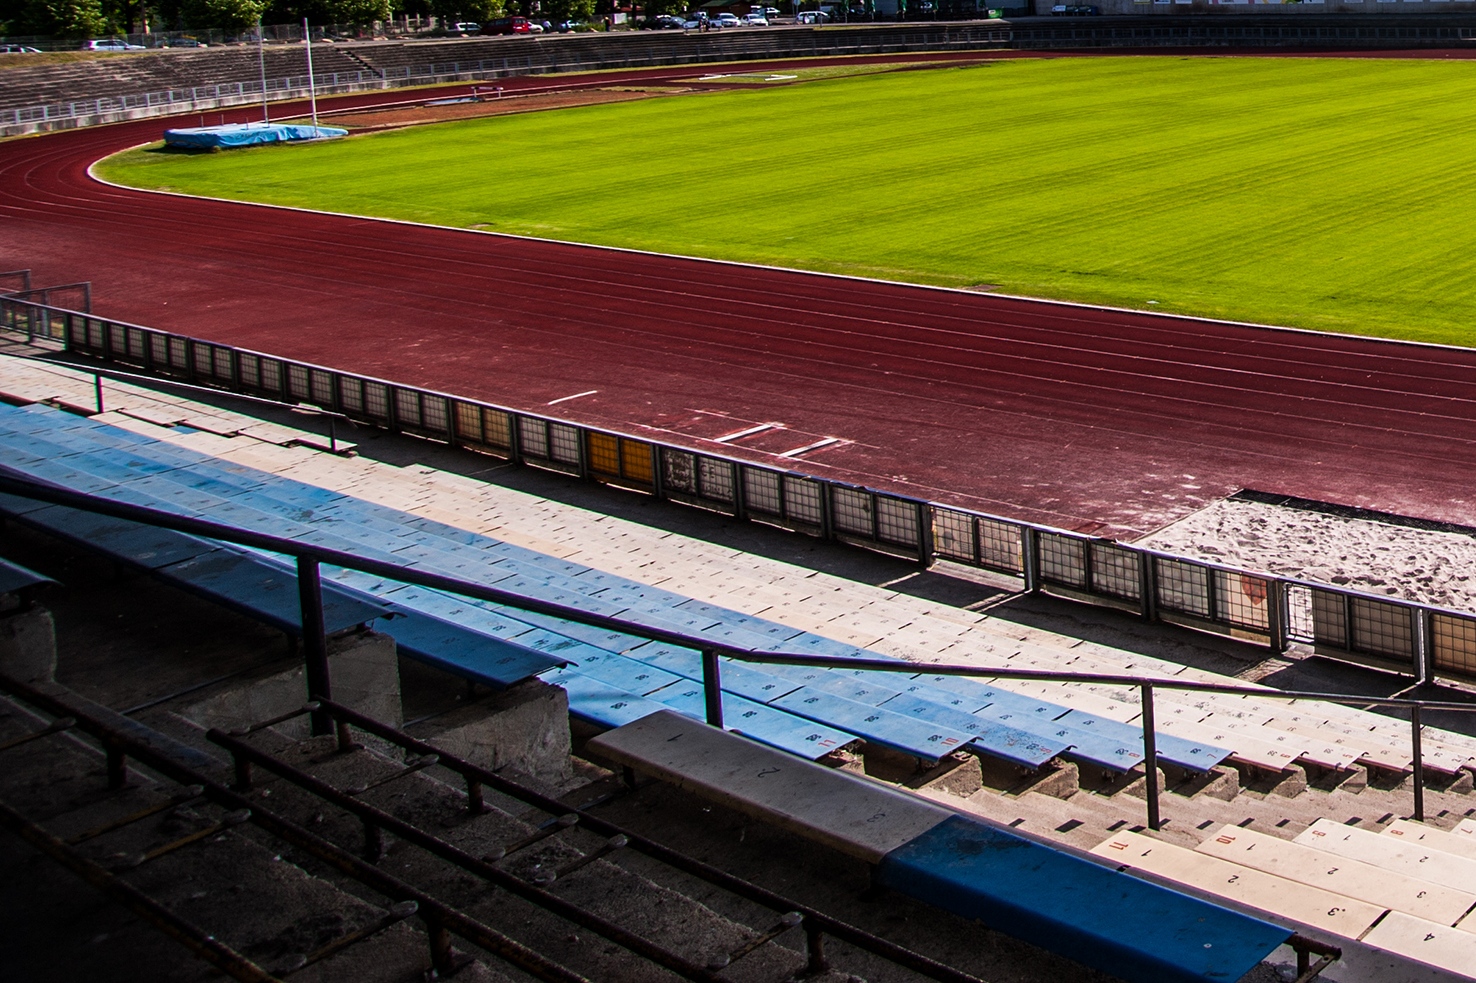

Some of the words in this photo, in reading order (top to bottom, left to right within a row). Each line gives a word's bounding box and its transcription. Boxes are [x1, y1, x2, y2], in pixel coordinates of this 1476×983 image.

[1216, 835, 1236, 845] 10
[1108, 841, 1129, 850] 11
[1327, 867, 1339, 875] 2
[1227, 874, 1239, 883] 2
[1416, 890, 1426, 899] 3
[1327, 907, 1340, 916] 3
[1423, 932, 1435, 942] 4
